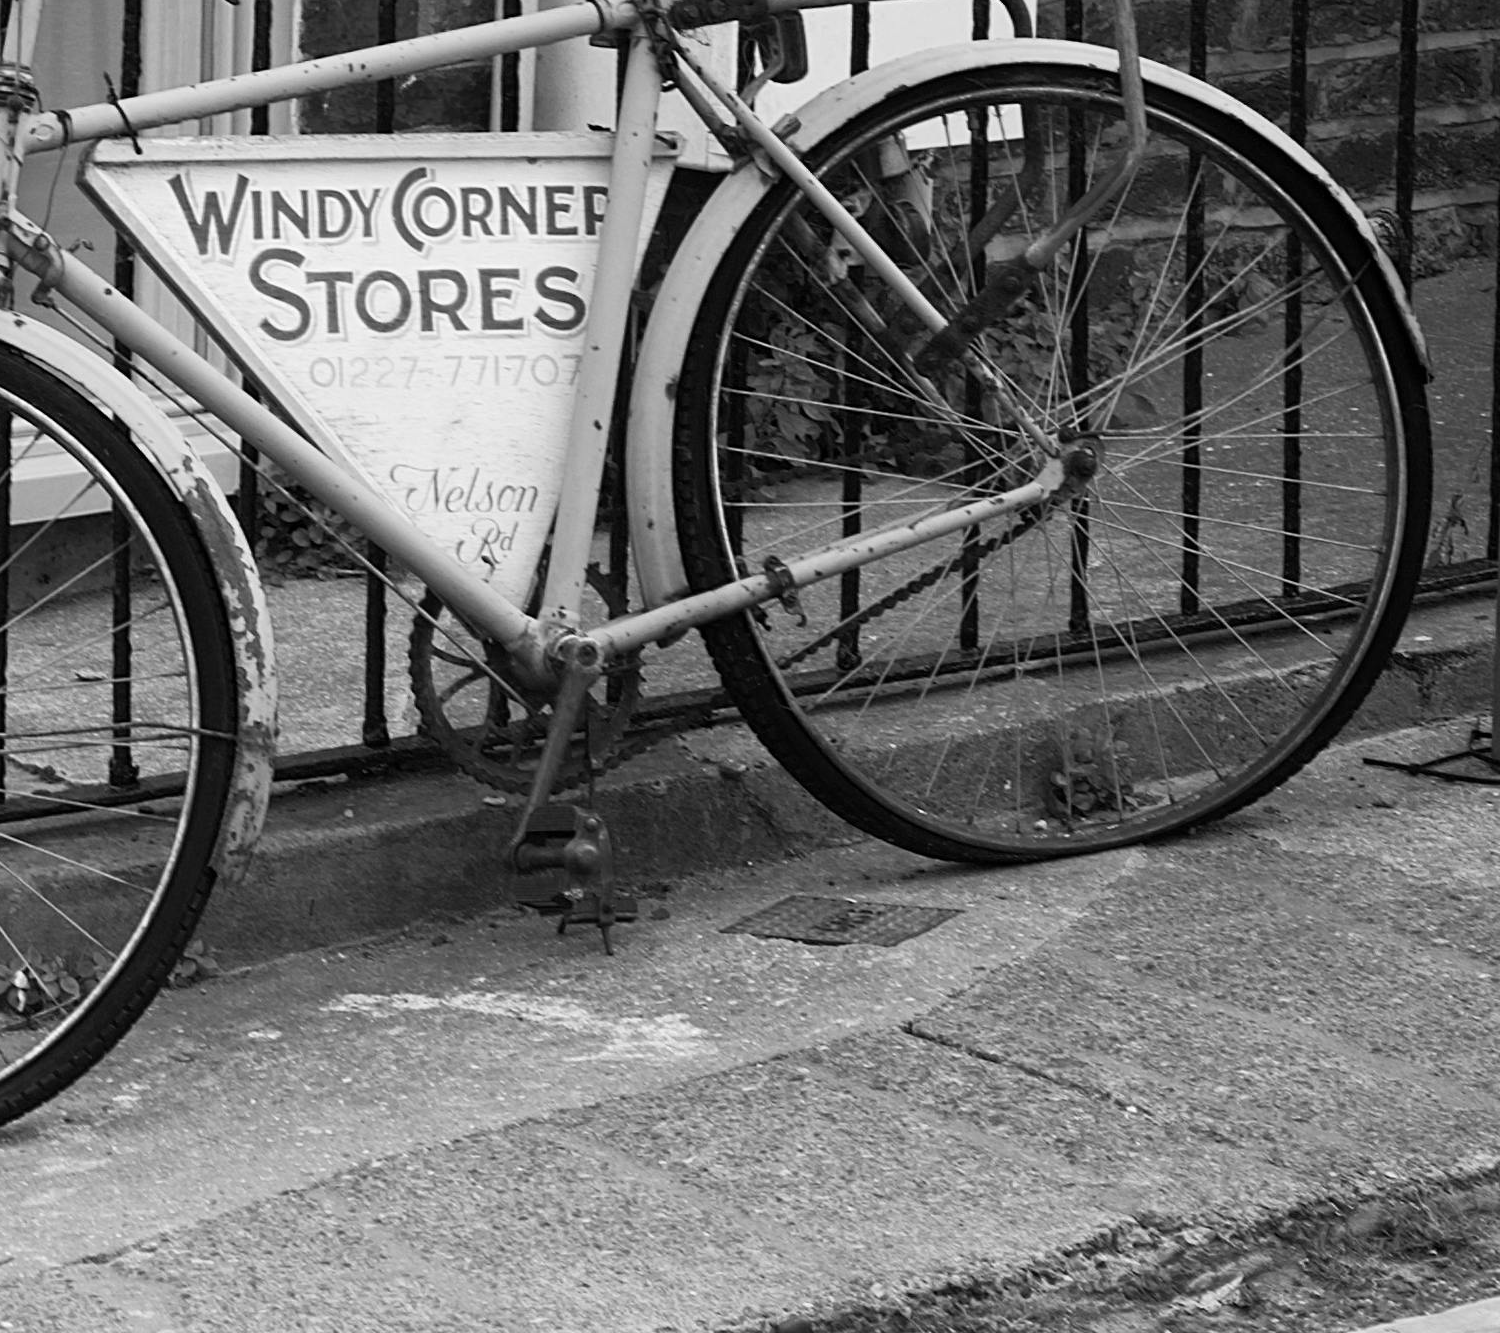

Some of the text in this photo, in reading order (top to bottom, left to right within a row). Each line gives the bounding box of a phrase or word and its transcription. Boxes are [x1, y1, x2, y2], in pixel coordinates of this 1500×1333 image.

[167, 171, 382, 257] WINDY
[247, 248, 588, 343] STORES
[309, 356, 420, 389] 01227
[389, 463, 540, 514] Nelson
